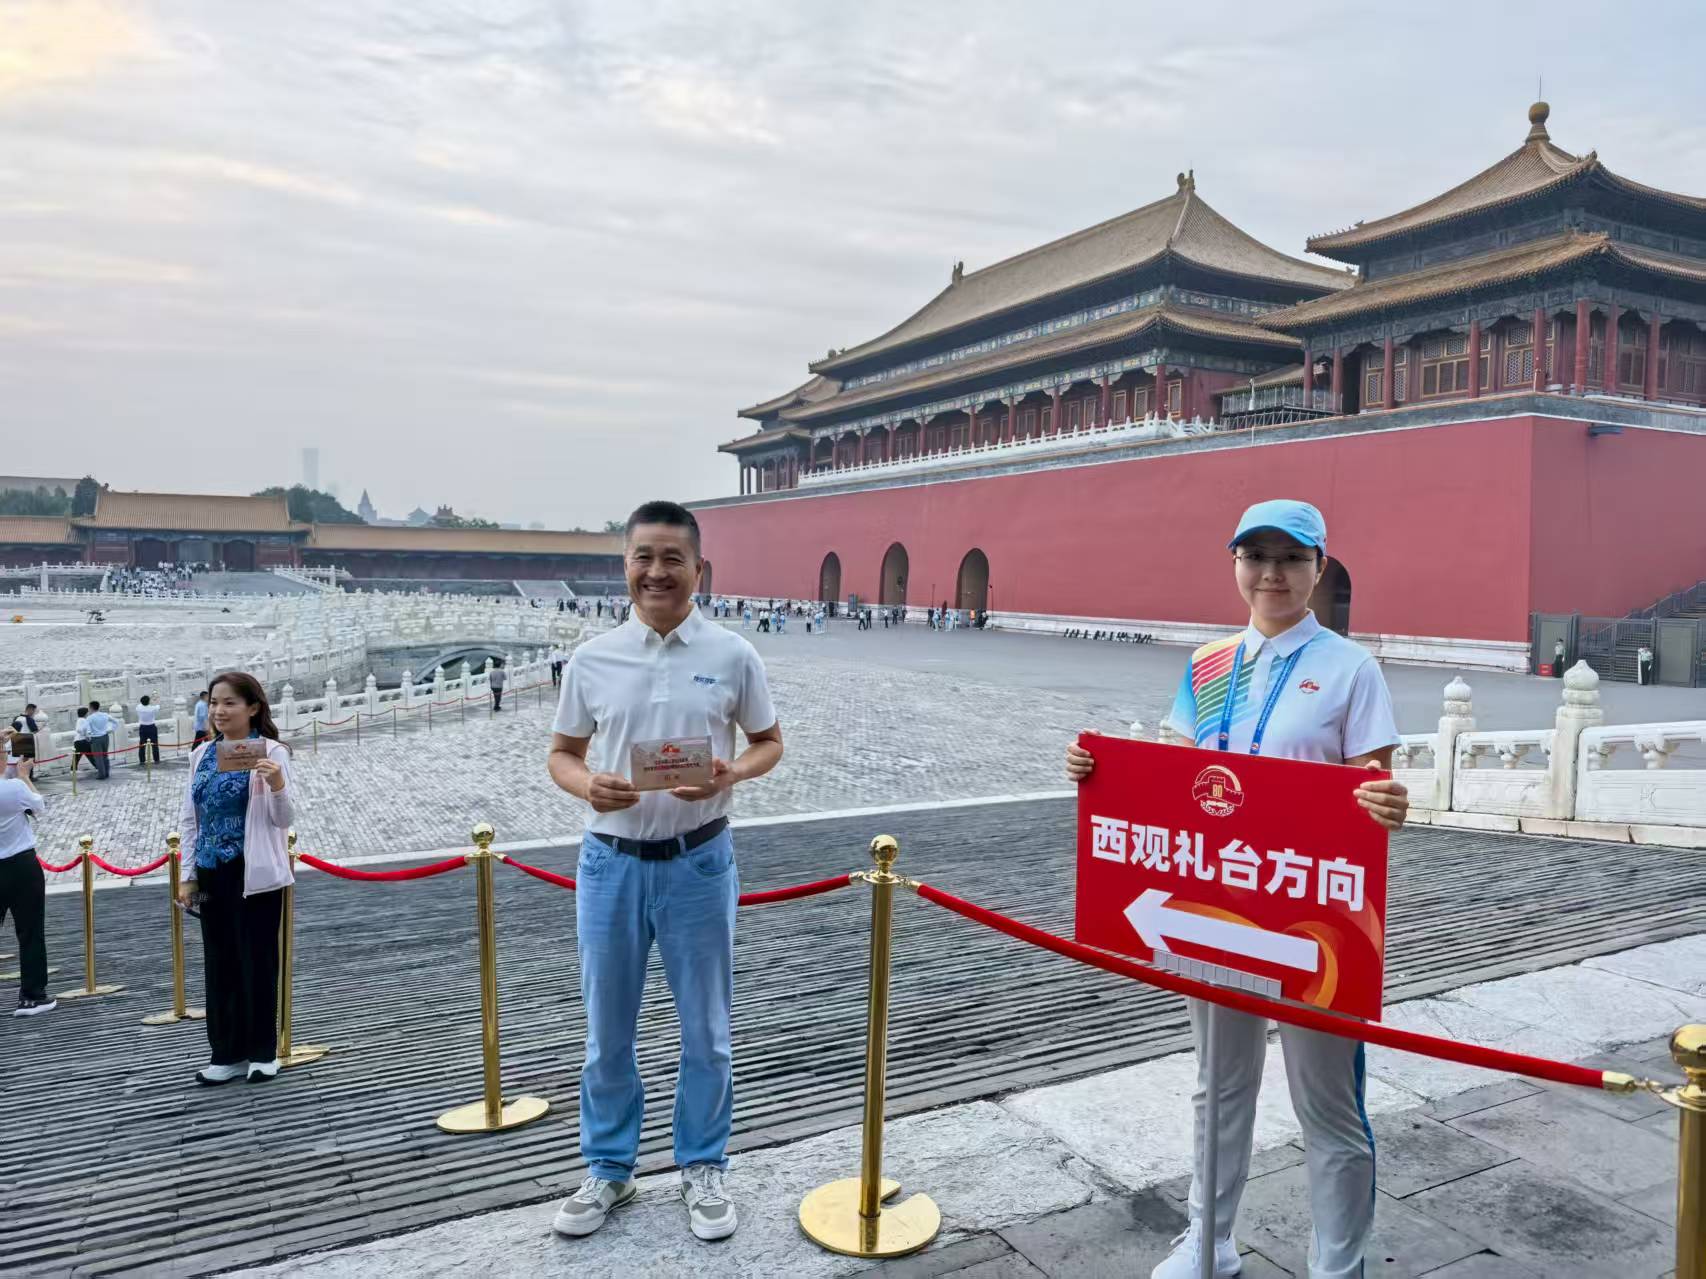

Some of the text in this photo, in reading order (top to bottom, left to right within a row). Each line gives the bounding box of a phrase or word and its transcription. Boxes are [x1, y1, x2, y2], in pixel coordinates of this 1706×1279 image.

[1212, 784, 1222, 797] 80
[1091, 815, 1365, 911] 西观礼台方向
